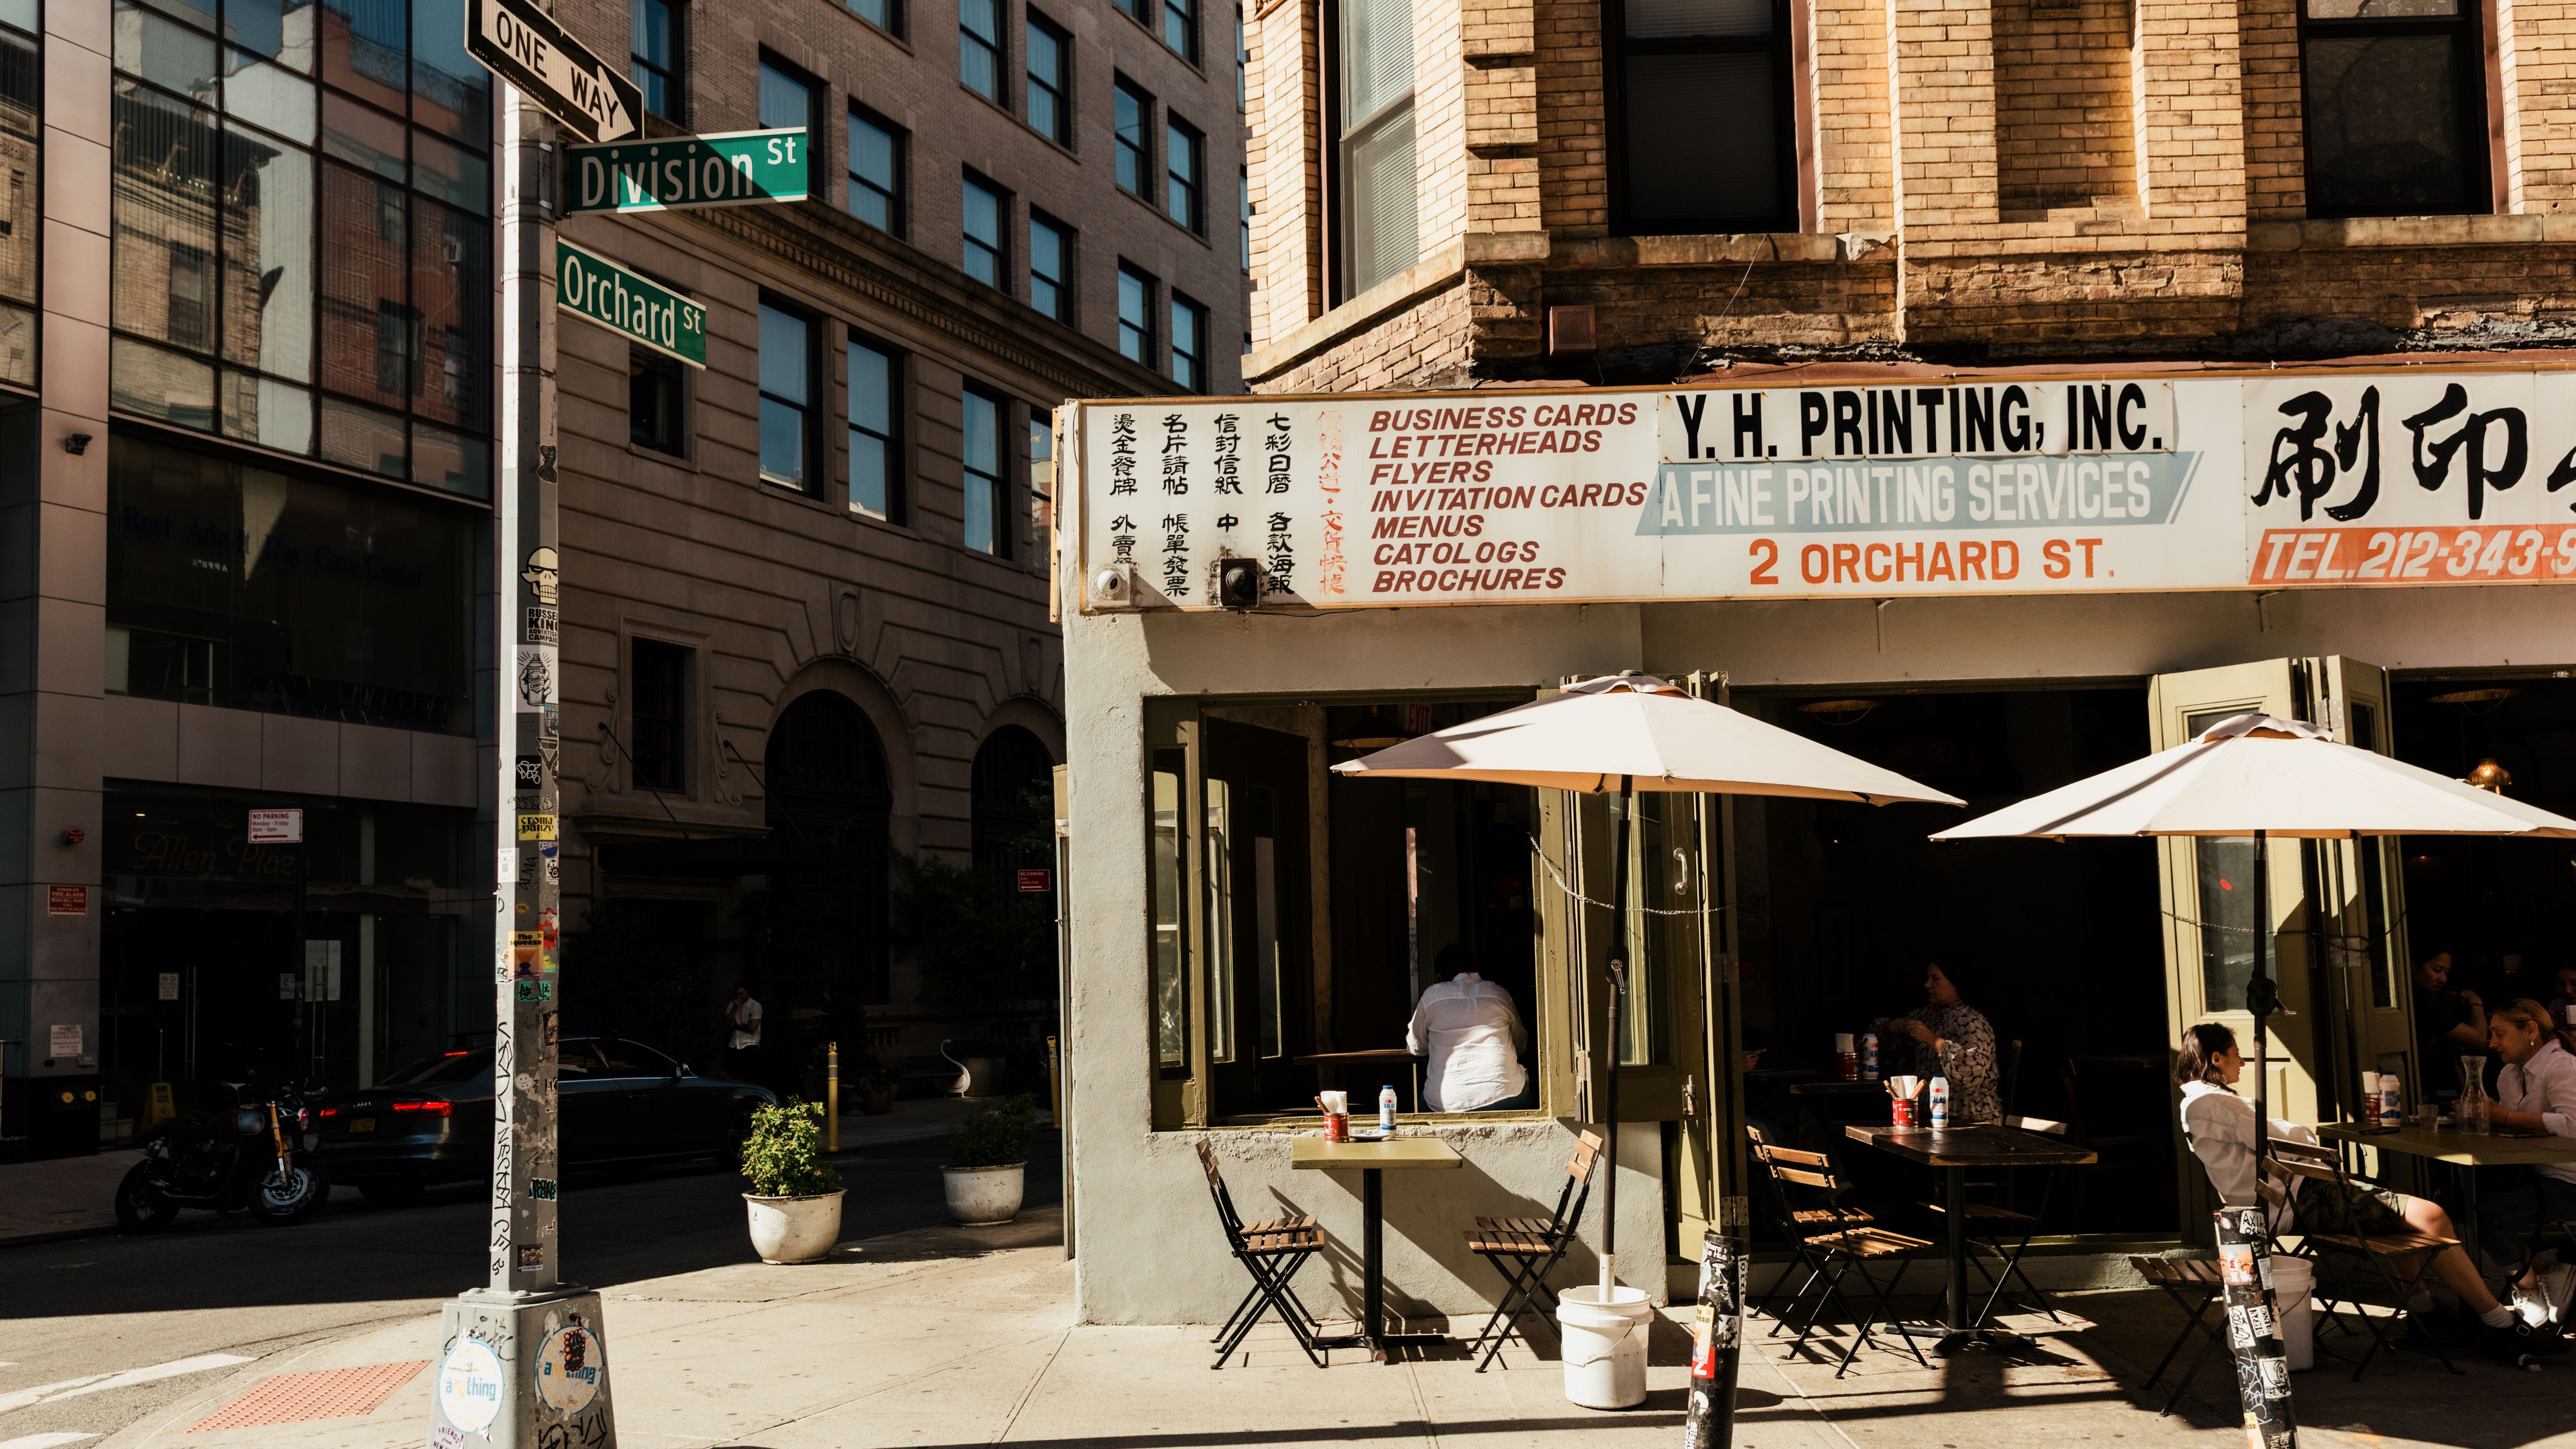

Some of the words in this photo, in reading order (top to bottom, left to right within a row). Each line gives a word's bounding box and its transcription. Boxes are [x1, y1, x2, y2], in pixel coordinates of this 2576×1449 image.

[475, 48, 488, 60] DEPT
[504, 69, 545, 103] TRANSPORTATION
[496, 11, 547, 79] ONE
[571, 66, 619, 128] WAY
[582, 144, 754, 207] Division
[767, 137, 797, 165] St
[564, 254, 675, 349] Orchard
[683, 305, 701, 334] St
[1369, 406, 1527, 433] BUSINESS
[1533, 402, 1638, 427] CARDS
[1676, 394, 1715, 459] Y.
[1733, 392, 1777, 457] H.
[1800, 385, 2044, 457] PRINTING,
[2067, 383, 2162, 451] INC.
[1161, 413, 1191, 497] 名片請帖
[1214, 413, 1244, 495] 信封信紙
[1369, 430, 1602, 459] LETTERHEADS
[1370, 460, 1493, 485] FLYERS
[1370, 485, 1536, 512] INVITATION
[1540, 482, 1647, 507] CARDS
[1661, 472, 1684, 527] A
[1690, 469, 1775, 527] FINE
[1787, 465, 1955, 525] PRINTING
[1968, 461, 2151, 521] SERVICES
[1371, 514, 1484, 539] MENUS
[125, 505, 170, 540] Best
[265, 535, 302, 570] Day
[315, 546, 359, 577] Care
[367, 554, 423, 587] Center
[1162, 513, 1191, 597] 帳單發票
[1373, 541, 1539, 565] CATOLOGS
[1749, 538, 1778, 585] 2
[1801, 540, 2020, 584] ORCHARD
[2043, 538, 2114, 579] ST.
[1372, 567, 1566, 593] BROCHURES
[529, 629, 557, 637] ADVERTISI
[1409, 704, 1430, 734] EXIT
[215, 797, 235, 829] 2
[131, 832, 216, 871] Allen
[2250, 1309, 2265, 1336] STEPAN
[2260, 1307, 2274, 1333] FILENKO
[446, 1376, 496, 1401] anything
[438, 1427, 460, 1444] FRIENDS
[442, 1436, 452, 1446] from
